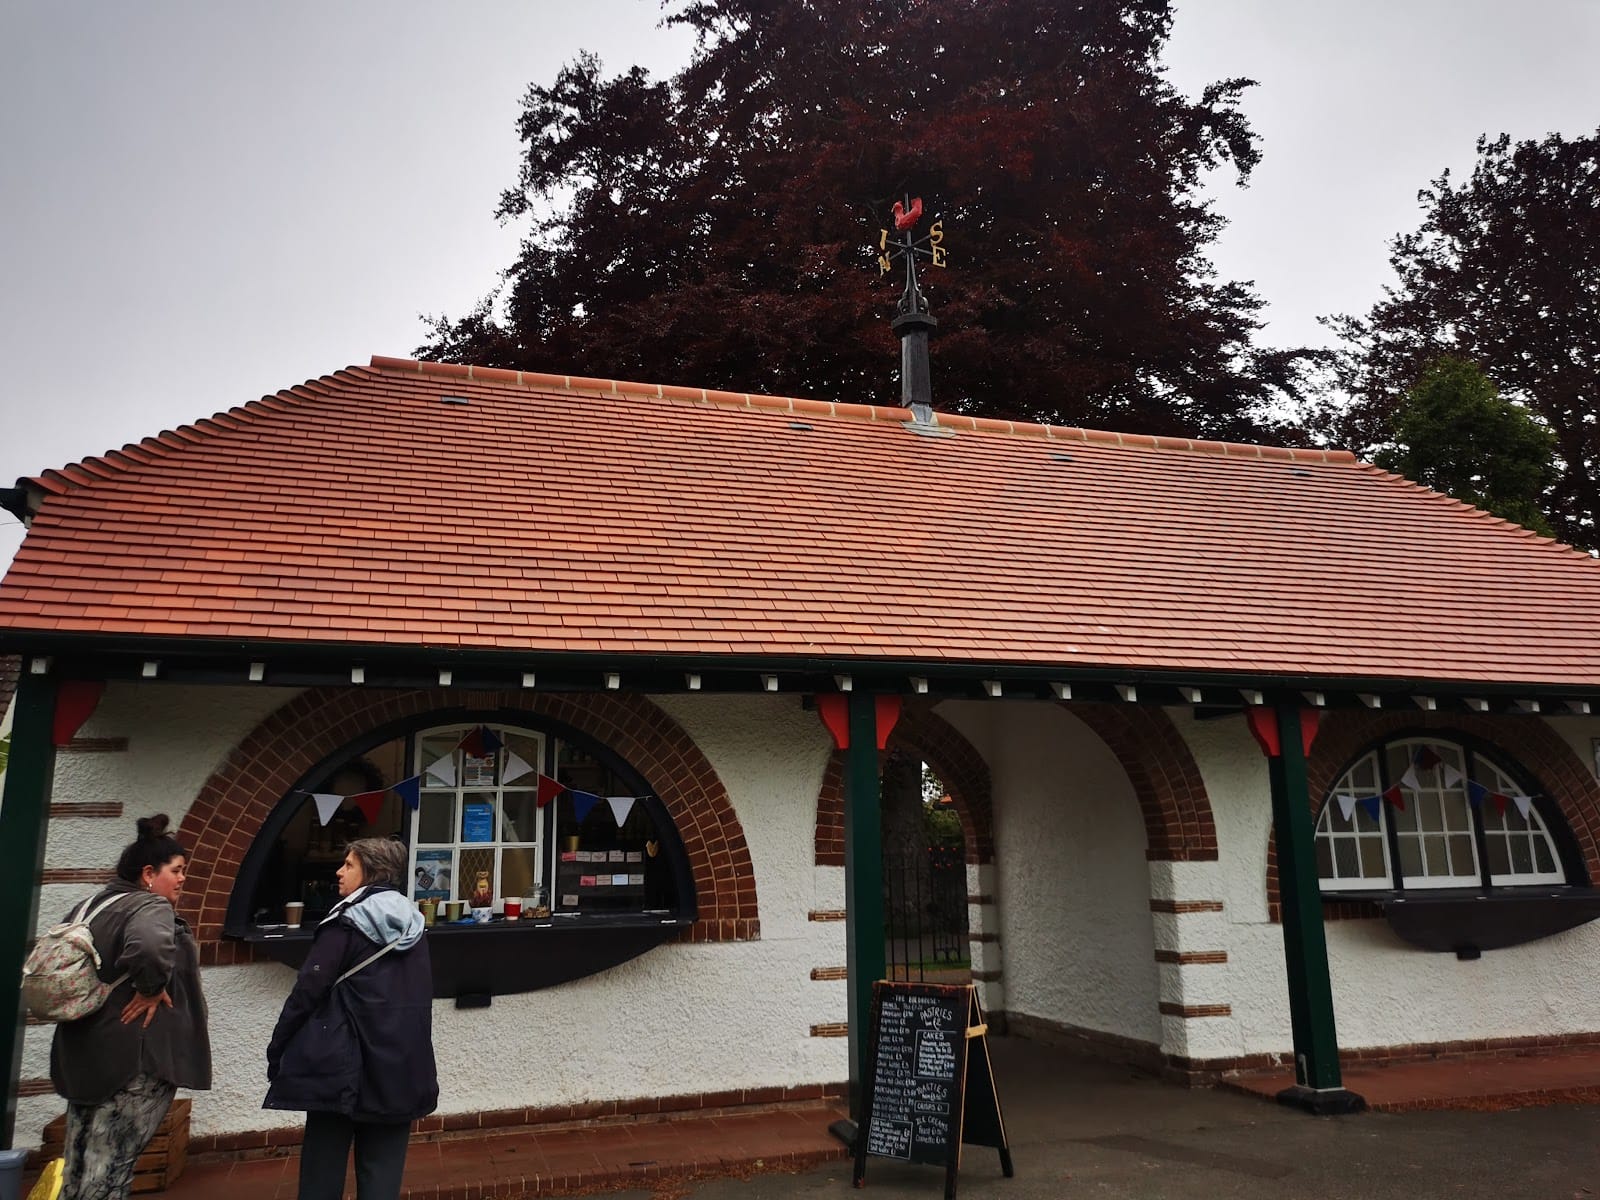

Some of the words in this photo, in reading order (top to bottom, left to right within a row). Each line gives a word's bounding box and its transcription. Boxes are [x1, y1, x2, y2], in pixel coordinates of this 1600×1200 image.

[929, 219, 944, 244] S
[932, 245, 947, 268] E
[920, 1007, 953, 1021] PASTRIES
[923, 1032, 944, 1040] CAKES
